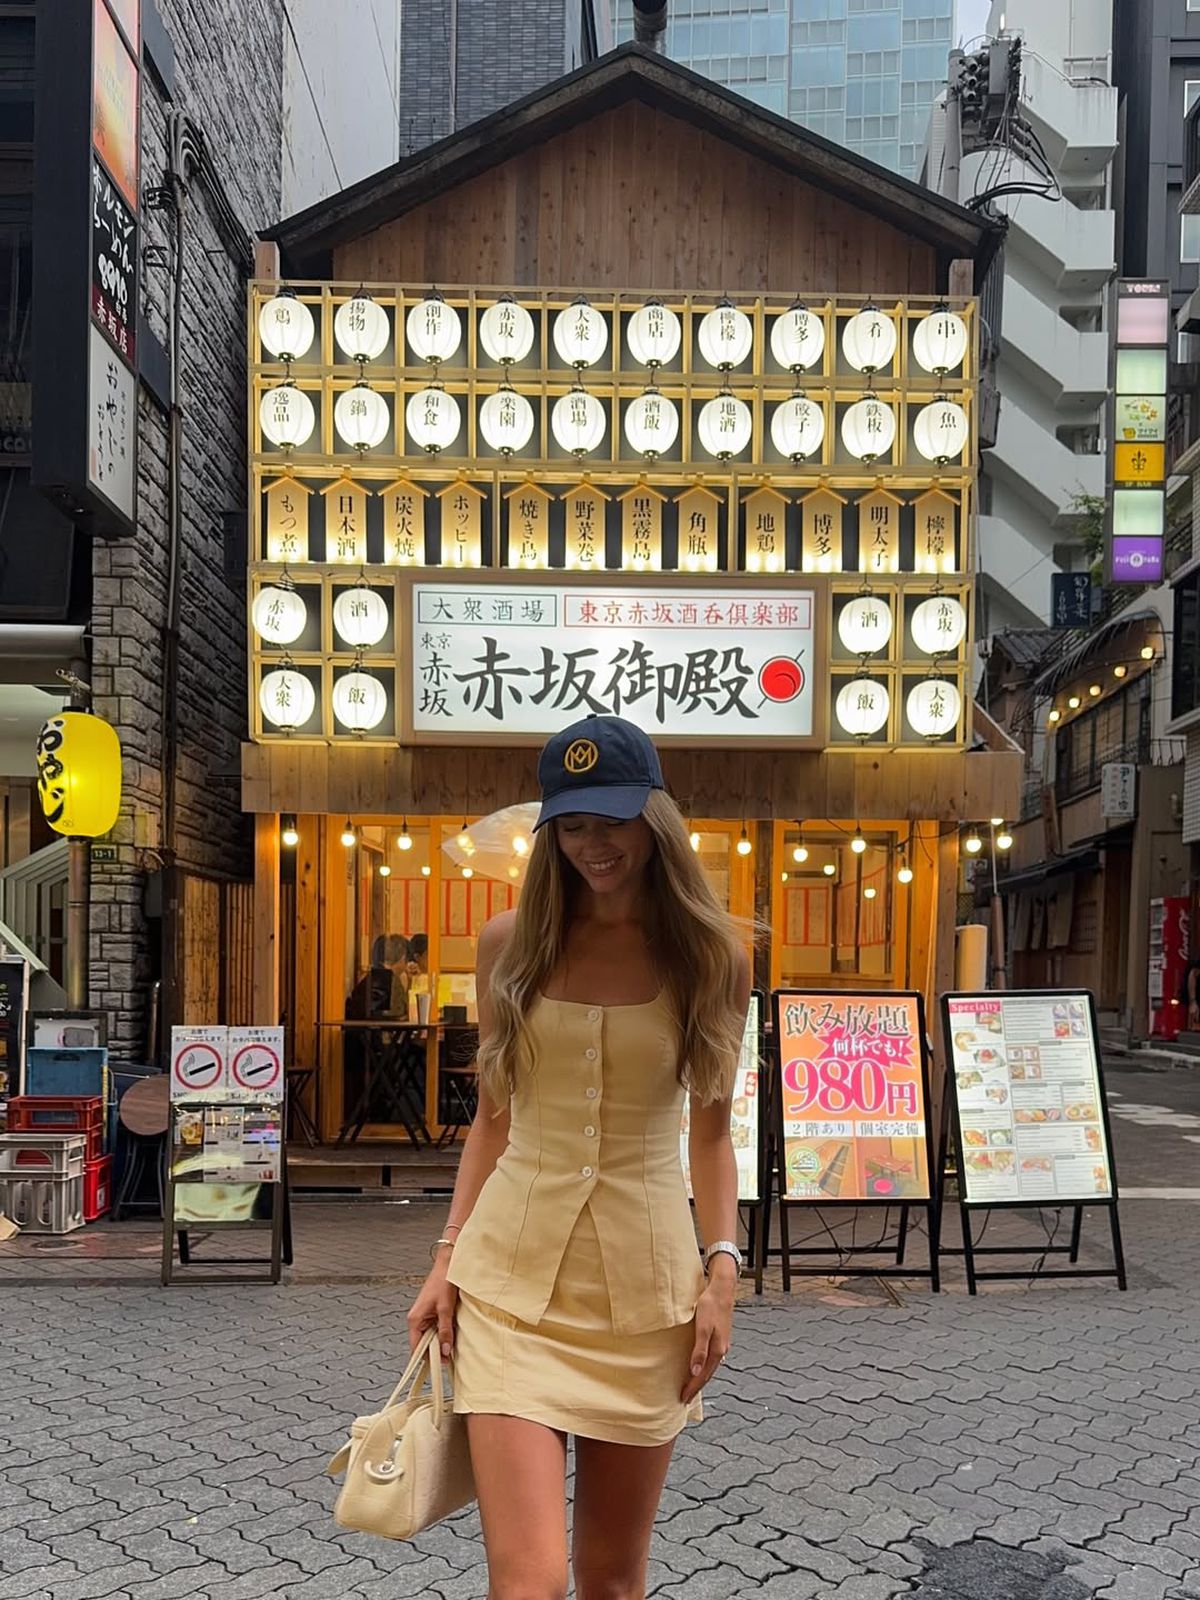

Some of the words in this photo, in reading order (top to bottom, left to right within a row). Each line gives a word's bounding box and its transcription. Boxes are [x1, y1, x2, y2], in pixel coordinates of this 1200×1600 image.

[97, 295, 128, 354] 赤坂店
[349, 301, 366, 332] 揚物
[425, 304, 442, 336] 創作
[498, 307, 516, 339] 赤坂
[574, 309, 590, 341] 大衆
[647, 307, 664, 339] 商店
[793, 312, 810, 344] 博多
[938, 319, 956, 339] 串
[272, 391, 290, 423] 逸品
[350, 399, 368, 417] 鍋
[423, 394, 440, 426] 和食
[499, 397, 516, 429] 楽園
[570, 396, 588, 427] 酒場
[644, 399, 660, 431] 酒飯
[719, 401, 737, 433] 地酒
[793, 402, 811, 434] 餃子
[866, 403, 882, 434] 鉄板
[939, 411, 957, 430] 魚
[278, 494, 298, 553] もつ煮
[337, 495, 356, 558] 日本酒
[394, 495, 415, 558] 炭火焼
[453, 495, 470, 562] ホッピー
[519, 499, 538, 561] 焼き鳥
[575, 499, 596, 563] 野菜巻
[631, 497, 652, 561] 黒霧島
[687, 511, 708, 556] 角瓶
[756, 513, 776, 555] 地鶏
[813, 513, 833, 556] 博多
[870, 505, 889, 567] 明太子
[926, 515, 945, 556] 檸檬
[265, 598, 285, 632] 赤坂
[350, 600, 369, 618] 酒
[431, 596, 545, 623] 大衆酒場
[577, 599, 799, 626] 東京赤坂酒呑倶楽部
[860, 610, 878, 628] 酒
[937, 602, 953, 633] 赤坂
[419, 631, 453, 650] 東京
[275, 675, 293, 707] 大衆
[348, 687, 367, 705] 飯
[418, 651, 454, 717] 赤坂
[453, 636, 760, 724] 赤坂御殿
[856, 693, 874, 711] 飯
[928, 686, 946, 718] 大衆
[785, 1002, 910, 1036] 飲み放題
[951, 1001, 999, 1013] Specialty
[784, 1059, 918, 1115] 980円
[792, 1122, 847, 1136] 2階あり
[860, 1122, 919, 1136] 個室完備
